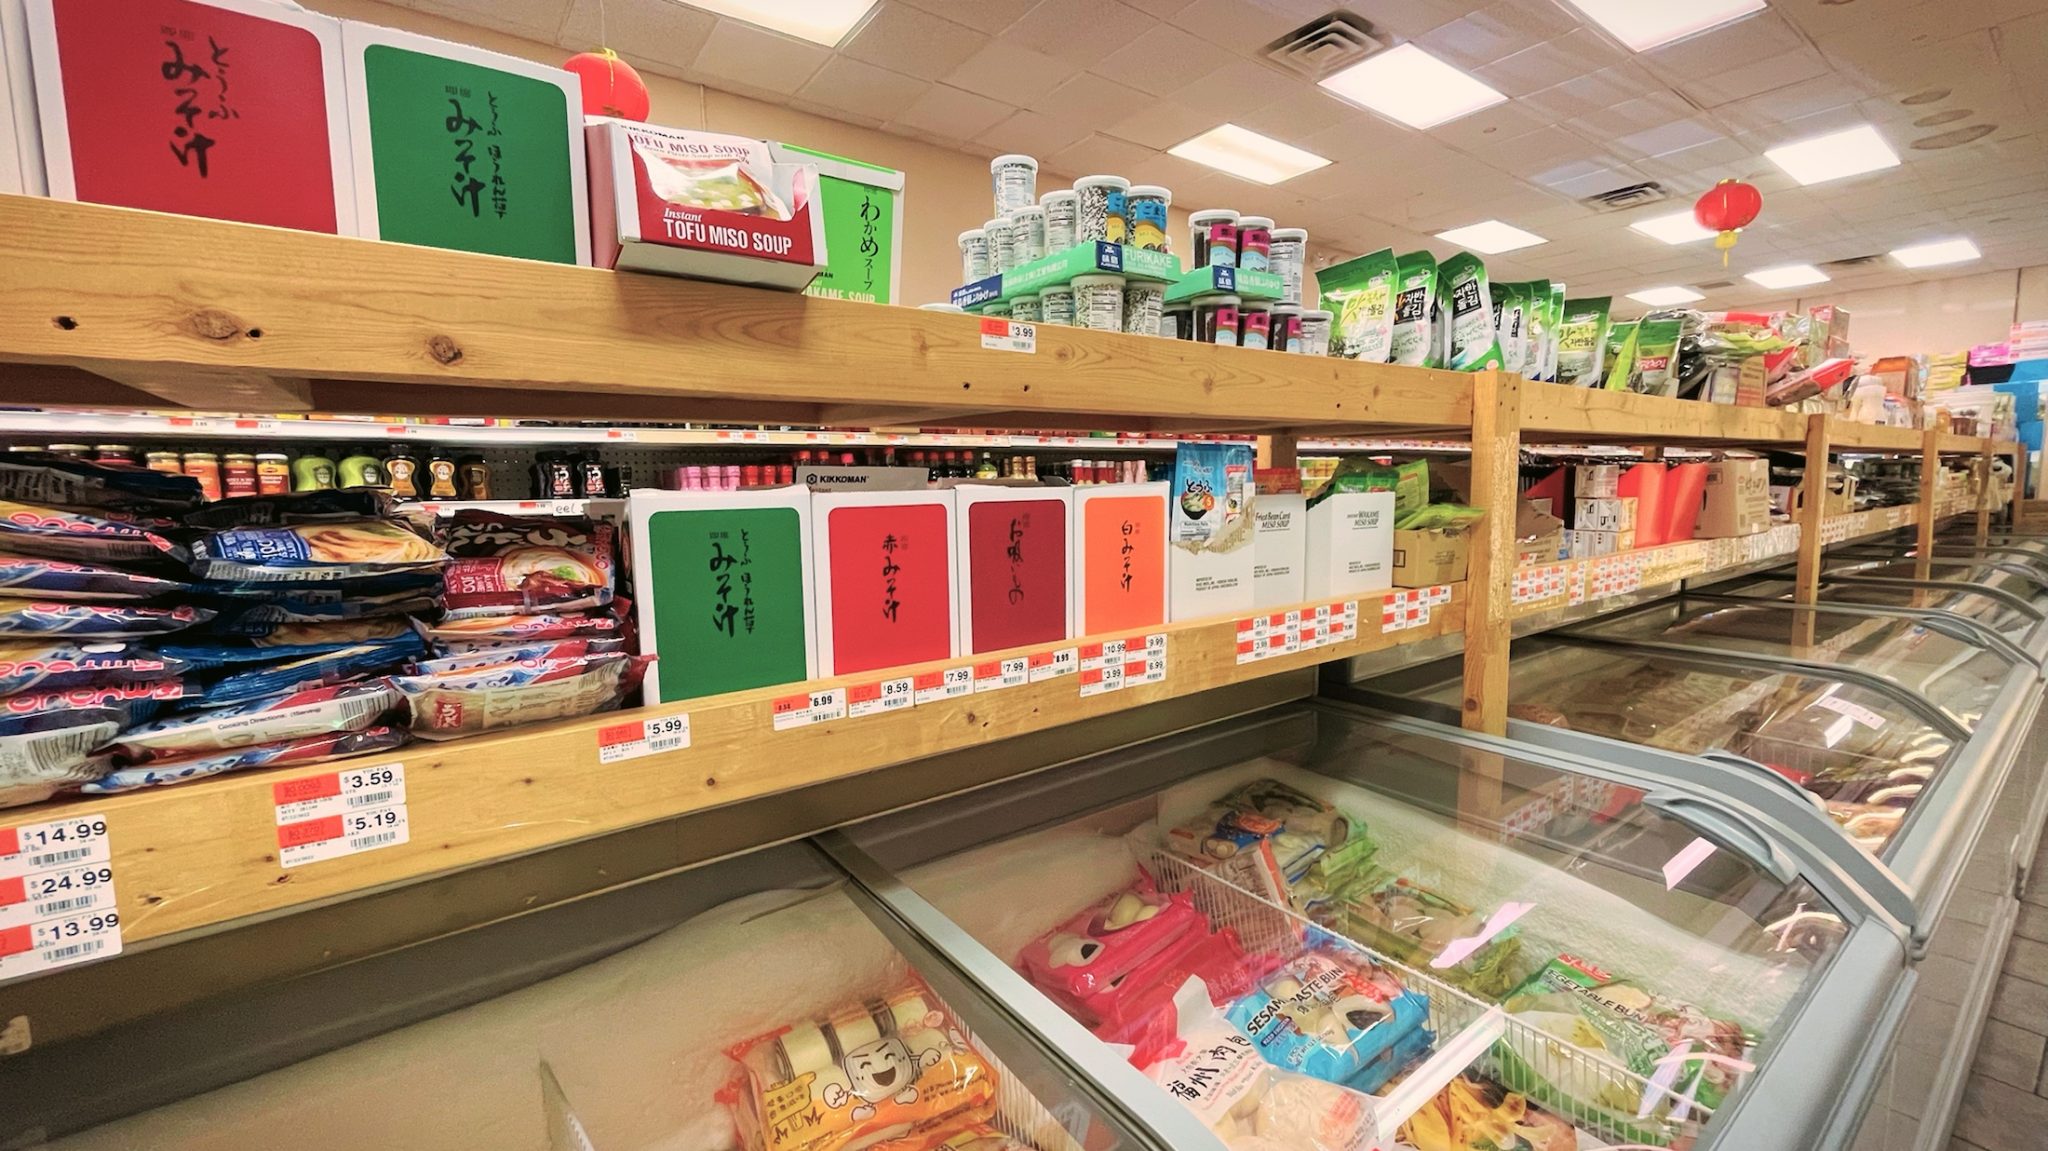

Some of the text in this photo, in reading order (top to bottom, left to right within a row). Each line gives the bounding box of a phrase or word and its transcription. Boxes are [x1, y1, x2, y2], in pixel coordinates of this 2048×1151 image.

[160, 40, 217, 178] みそ汁
[446, 98, 486, 218] みそ汁
[632, 134, 750, 157] OFU MISO SOUP
[664, 207, 702, 222] Instant
[663, 218, 792, 255] TOFU MISO SOUP
[1124, 248, 1173, 269] FURIKAKE
[820, 475, 867, 484] KIKKOMAN
[555, 503, 576, 514] eel
[1120, 520, 1134, 593] 白みそ汁
[709, 542, 738, 638] みそ汁
[882, 534, 900, 623] 赤みそ汁
[218, 719, 248, 731] Cooking
[1247, 997, 1288, 1036] SESAM
[1320, 966, 1344, 986] BUN
[1613, 1003, 1646, 1023] BUN
[1167, 1035, 1251, 1101] 福州肉包
